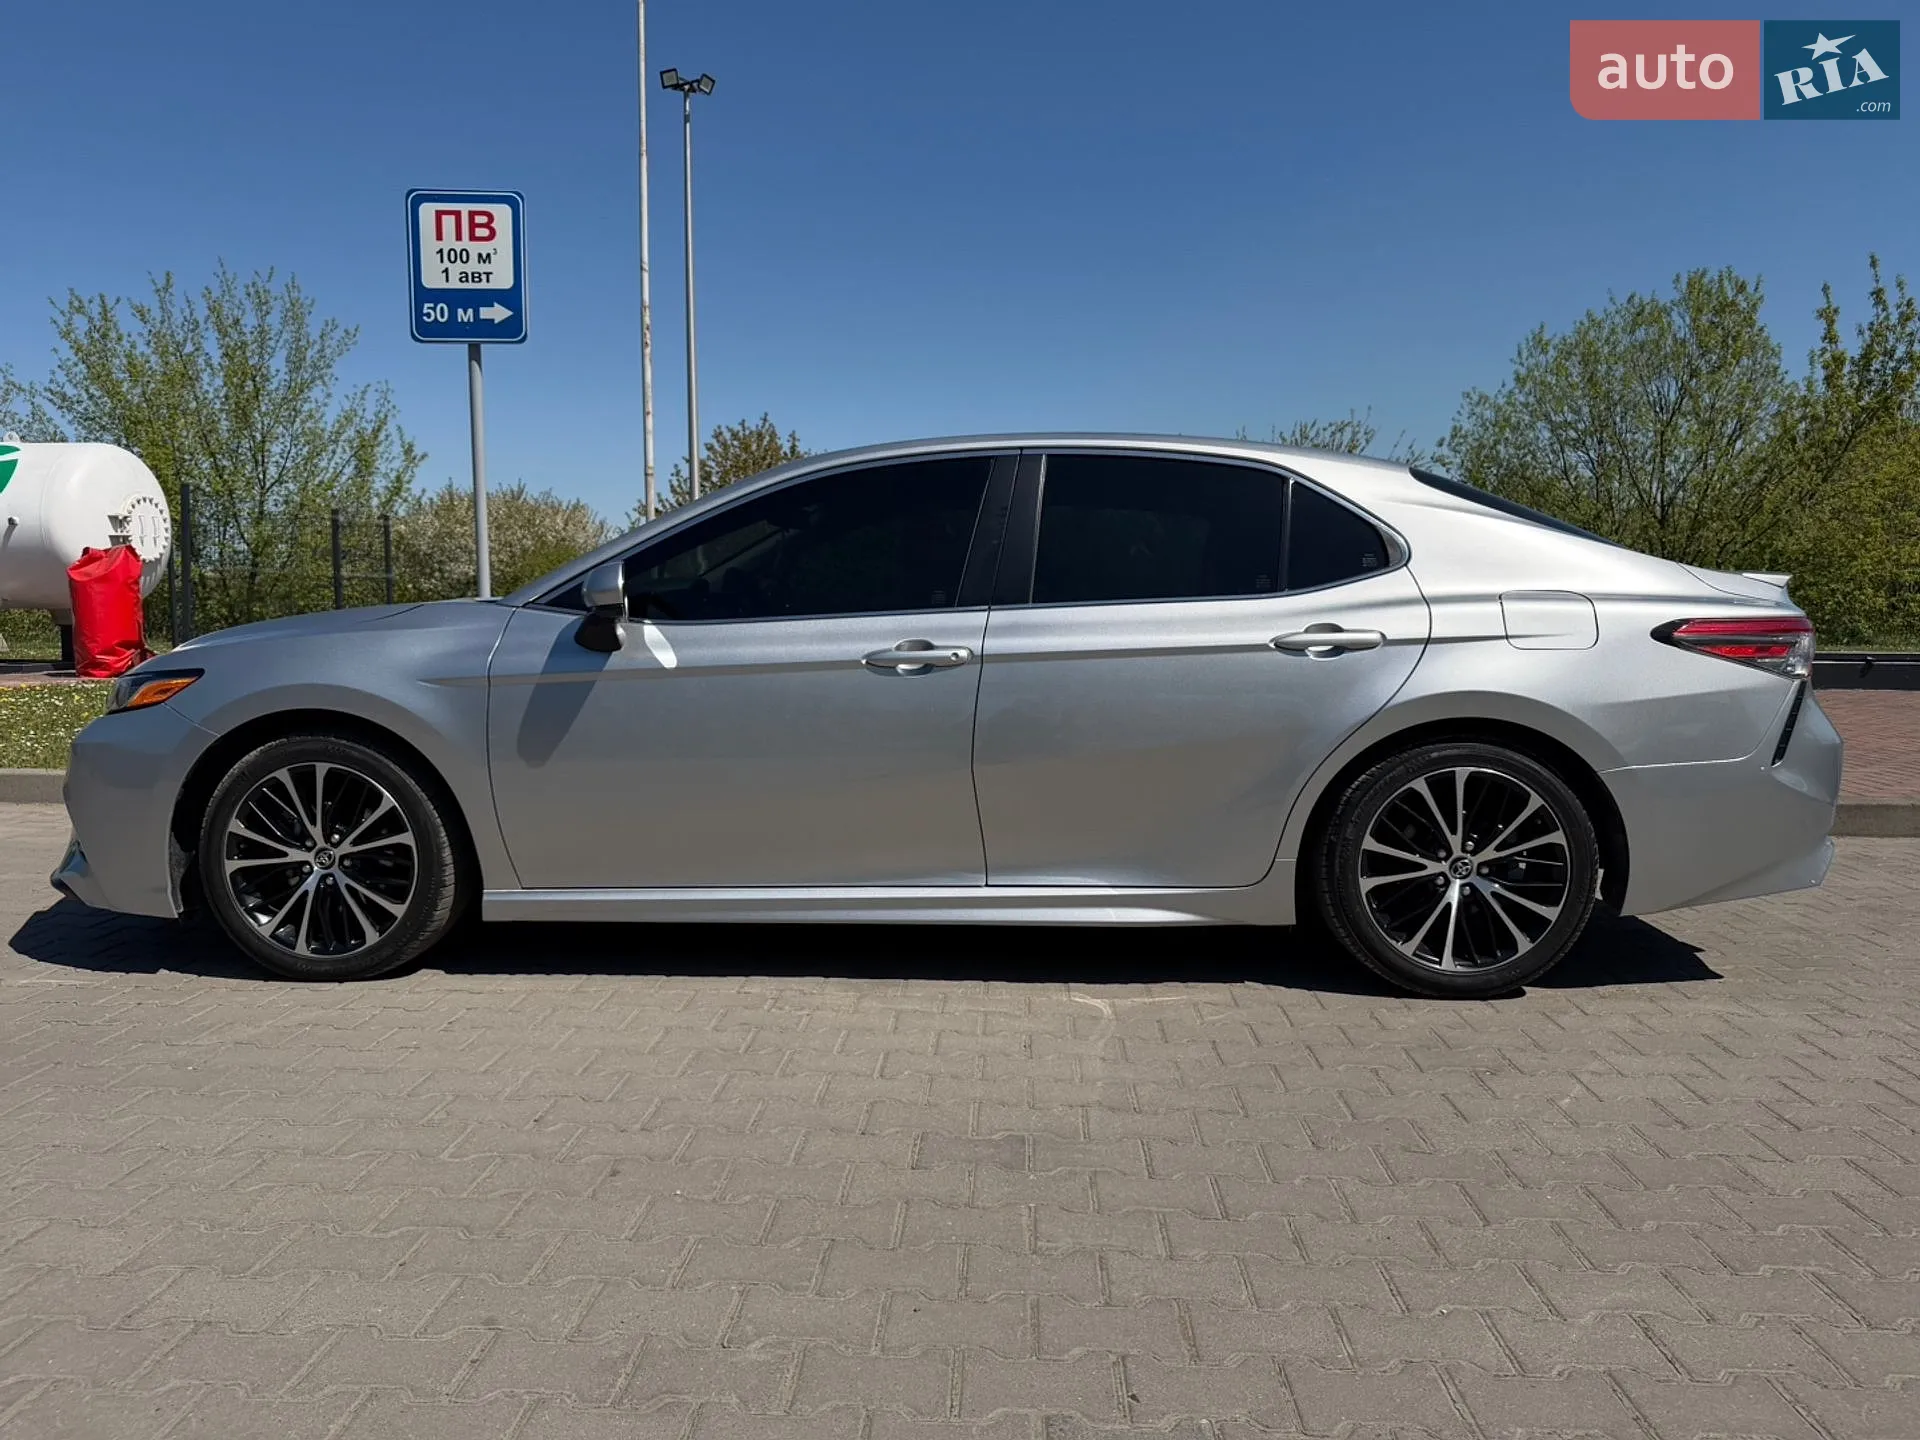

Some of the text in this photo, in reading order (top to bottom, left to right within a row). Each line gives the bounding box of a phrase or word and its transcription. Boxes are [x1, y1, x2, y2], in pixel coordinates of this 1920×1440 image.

[434, 209, 497, 242] ПВ
[435, 247, 470, 264] 100
[441, 267, 493, 284] 1 авт
[422, 303, 474, 323] 50 м
